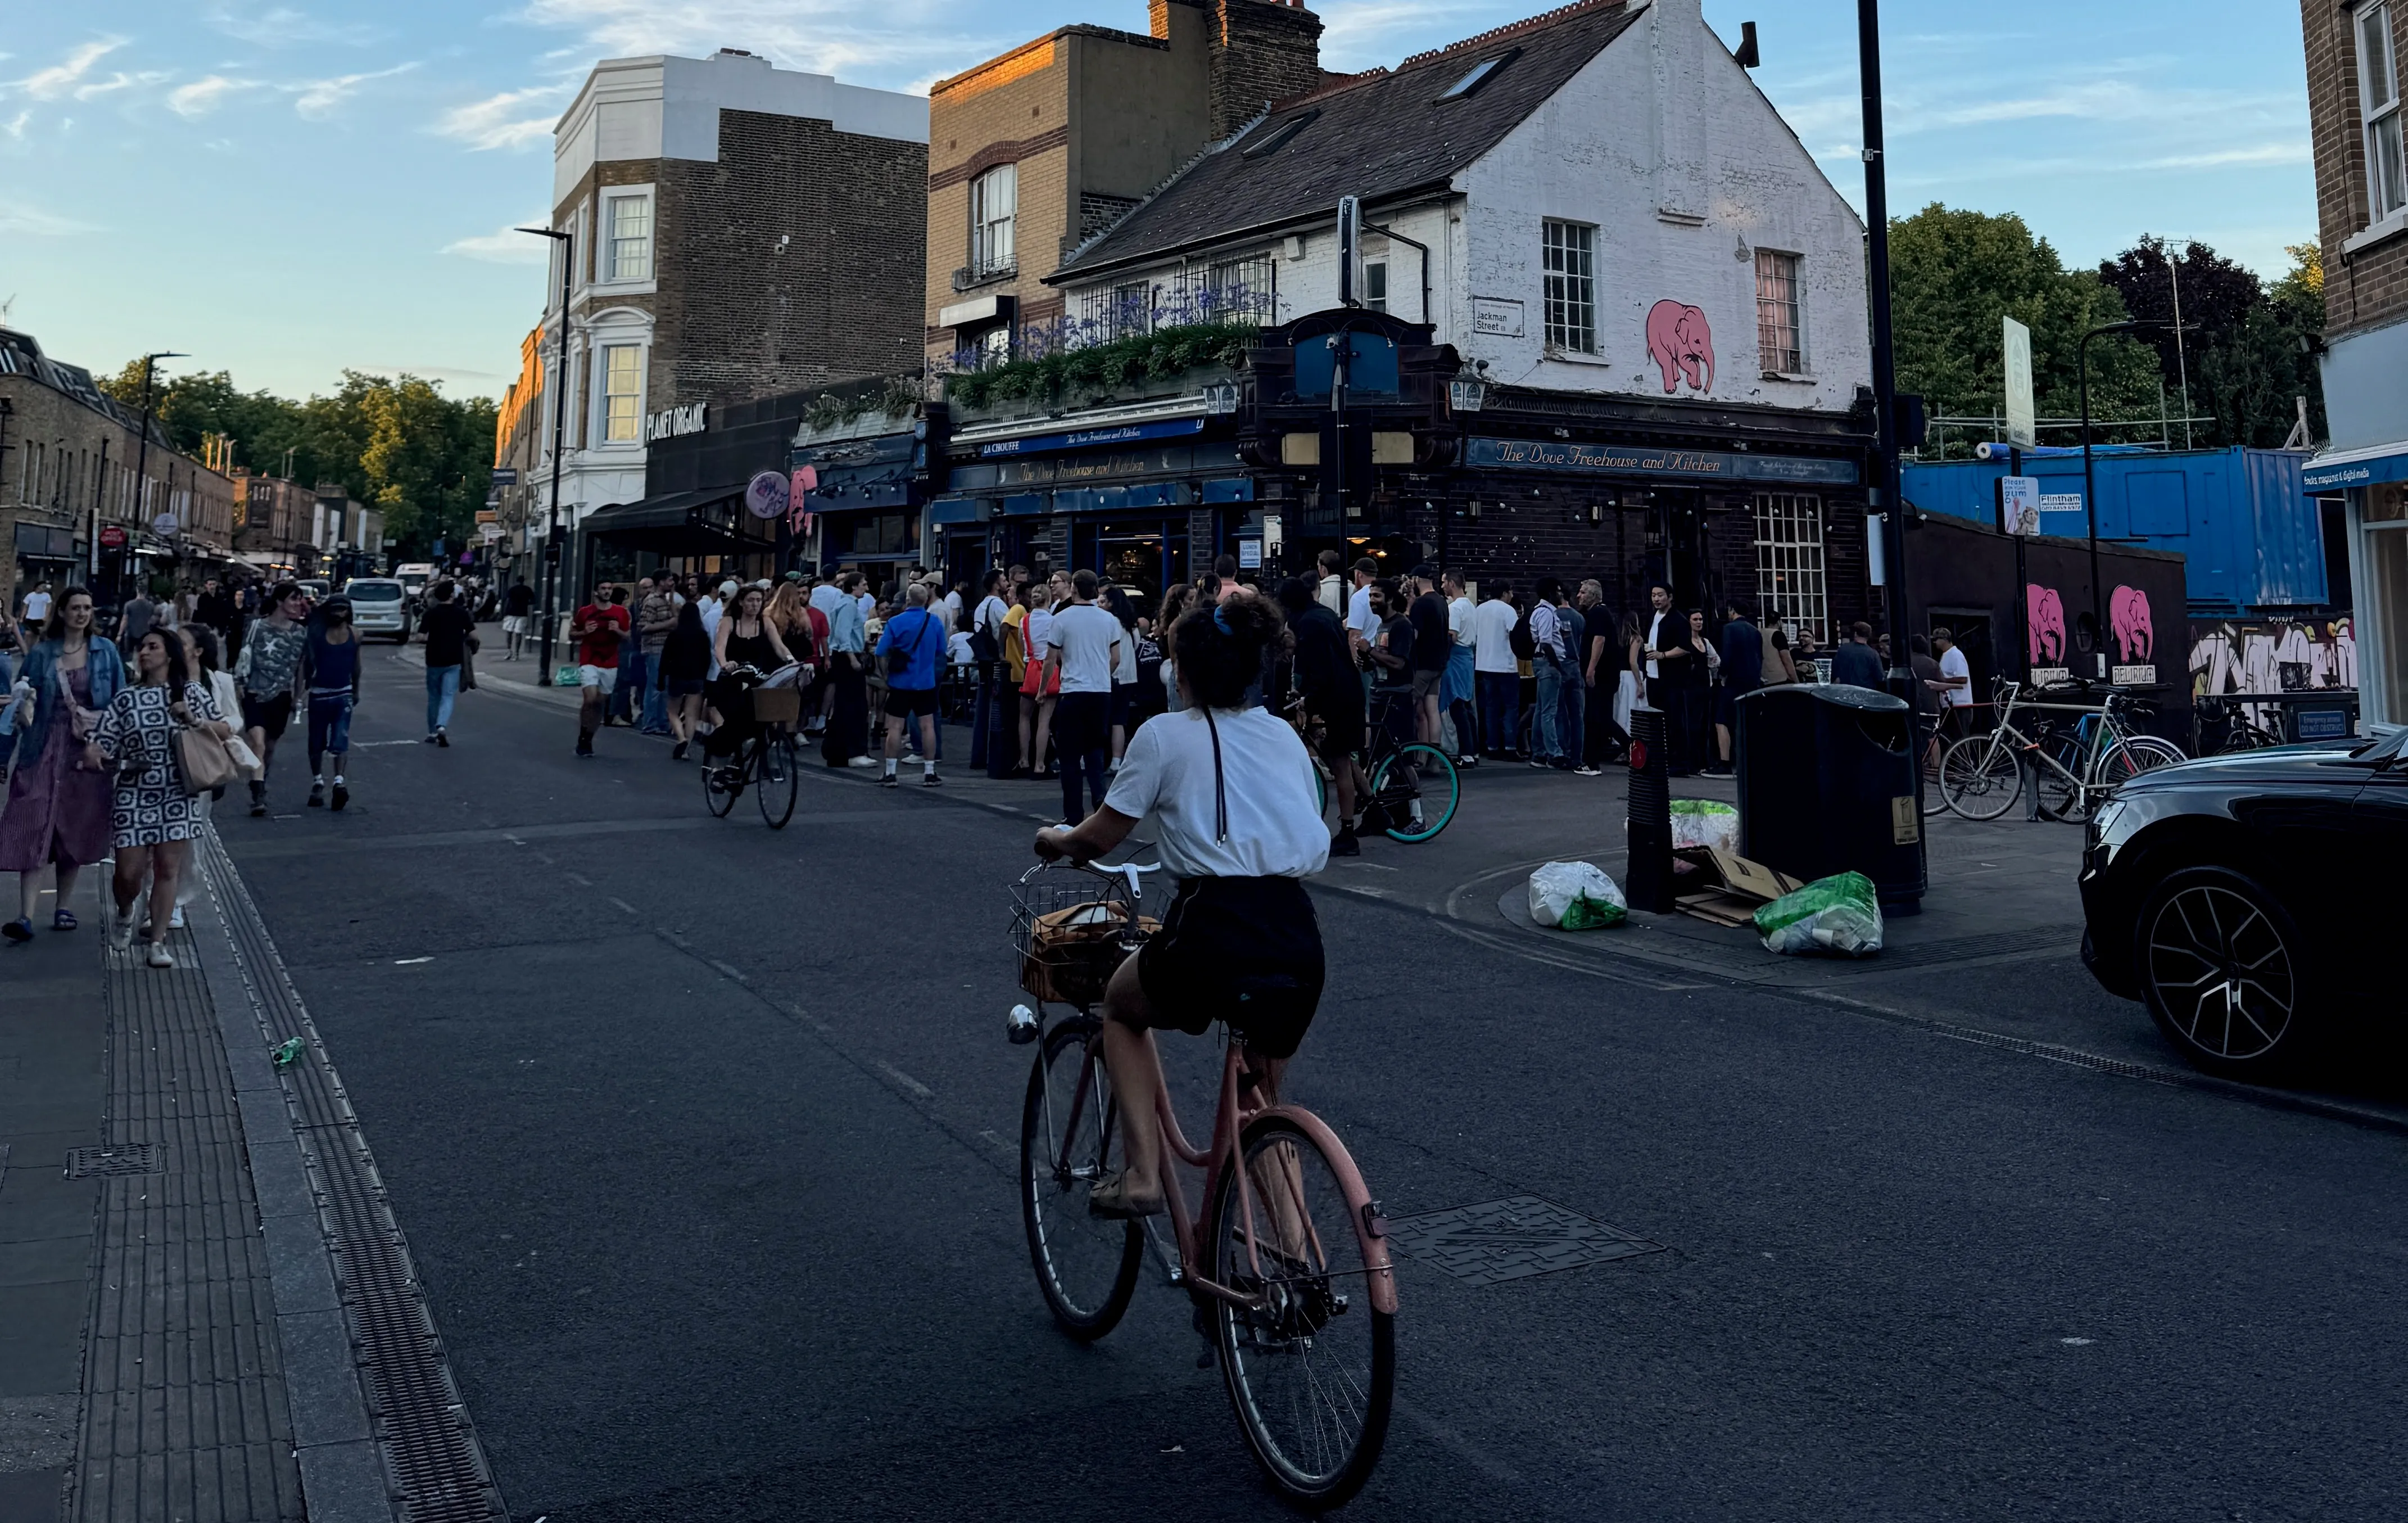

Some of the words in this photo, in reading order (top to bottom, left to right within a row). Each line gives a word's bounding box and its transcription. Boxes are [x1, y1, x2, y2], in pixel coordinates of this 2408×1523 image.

[1477, 310, 1507, 322] Jackman
[1477, 320, 1499, 331] Street
[646, 409, 673, 441] PLANET
[673, 401, 707, 436] ORGANIC
[1111, 428, 1122, 439] and
[984, 444, 992, 454] LA
[992, 441, 1020, 453] CHOUFFE
[1496, 442, 1524, 462] The
[1528, 442, 1564, 464] Dove
[1567, 445, 1638, 468] Freehouse
[1642, 451, 1667, 469] and
[1667, 451, 1721, 472] Kitchen
[1018, 462, 1035, 482] The
[1036, 461, 1056, 480] Dove
[1057, 457, 1095, 478] Freehouse
[1096, 454, 1112, 475] and
[1114, 453, 1144, 473] Kitchen
[2004, 490, 2027, 504] gum
[2114, 667, 2154, 683] DELIRIUM
